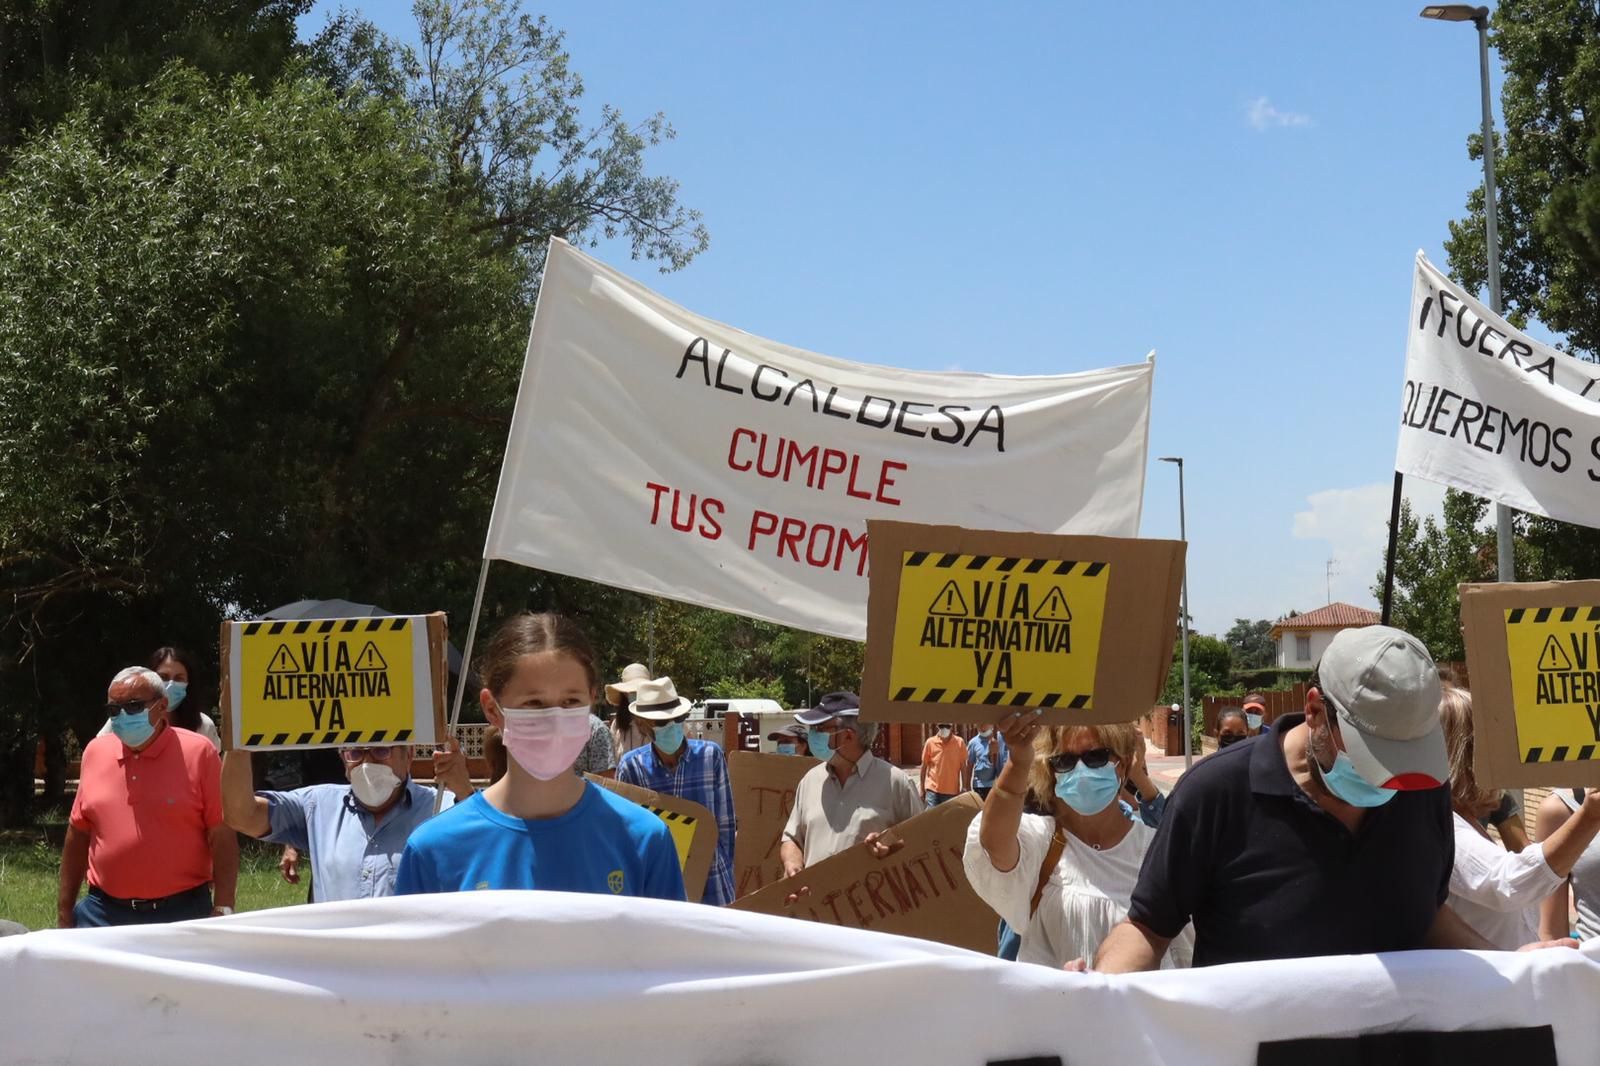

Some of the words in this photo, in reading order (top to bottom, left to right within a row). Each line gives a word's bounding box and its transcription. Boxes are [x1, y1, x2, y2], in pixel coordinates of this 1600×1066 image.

[676, 336, 1006, 452] ALCALDESA
[1402, 380, 1573, 473] QUEREMOS
[727, 427, 908, 506] CUMPLE
[646, 481, 724, 541] TUS
[748, 509, 870, 578] PROM
[973, 575, 1029, 620] VÍA
[301, 635, 351, 673] VÍA
[920, 616, 1071, 654] ALTERNATIVA
[263, 671, 391, 700] ALTERNATIVA
[974, 651, 1013, 689] YA
[308, 699, 346, 730] YA
